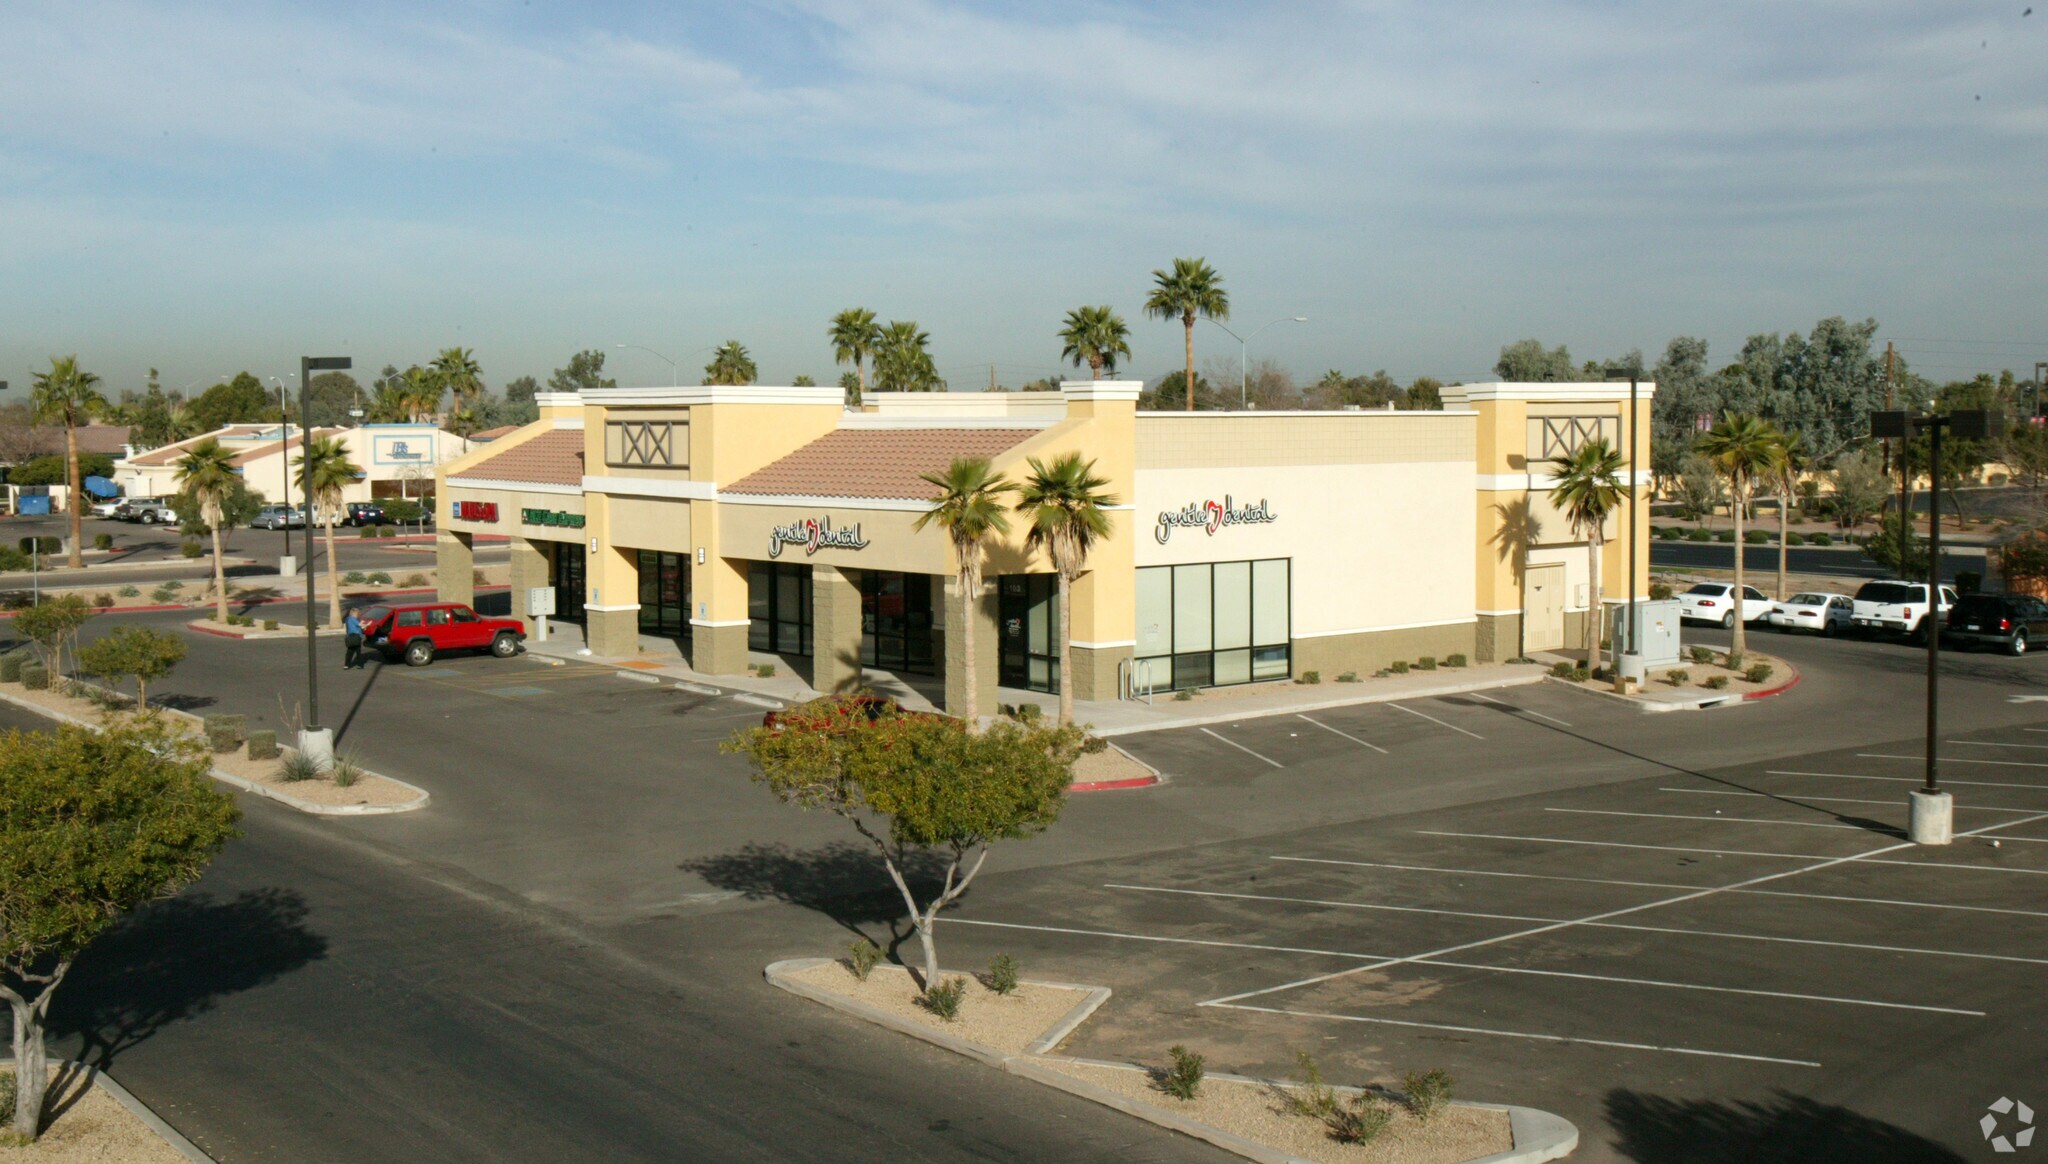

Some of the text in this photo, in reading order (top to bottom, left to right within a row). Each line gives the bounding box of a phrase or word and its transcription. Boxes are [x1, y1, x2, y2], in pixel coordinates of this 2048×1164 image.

[769, 515, 869, 556] gentle dental
[1156, 494, 1278, 544] gentle dental
